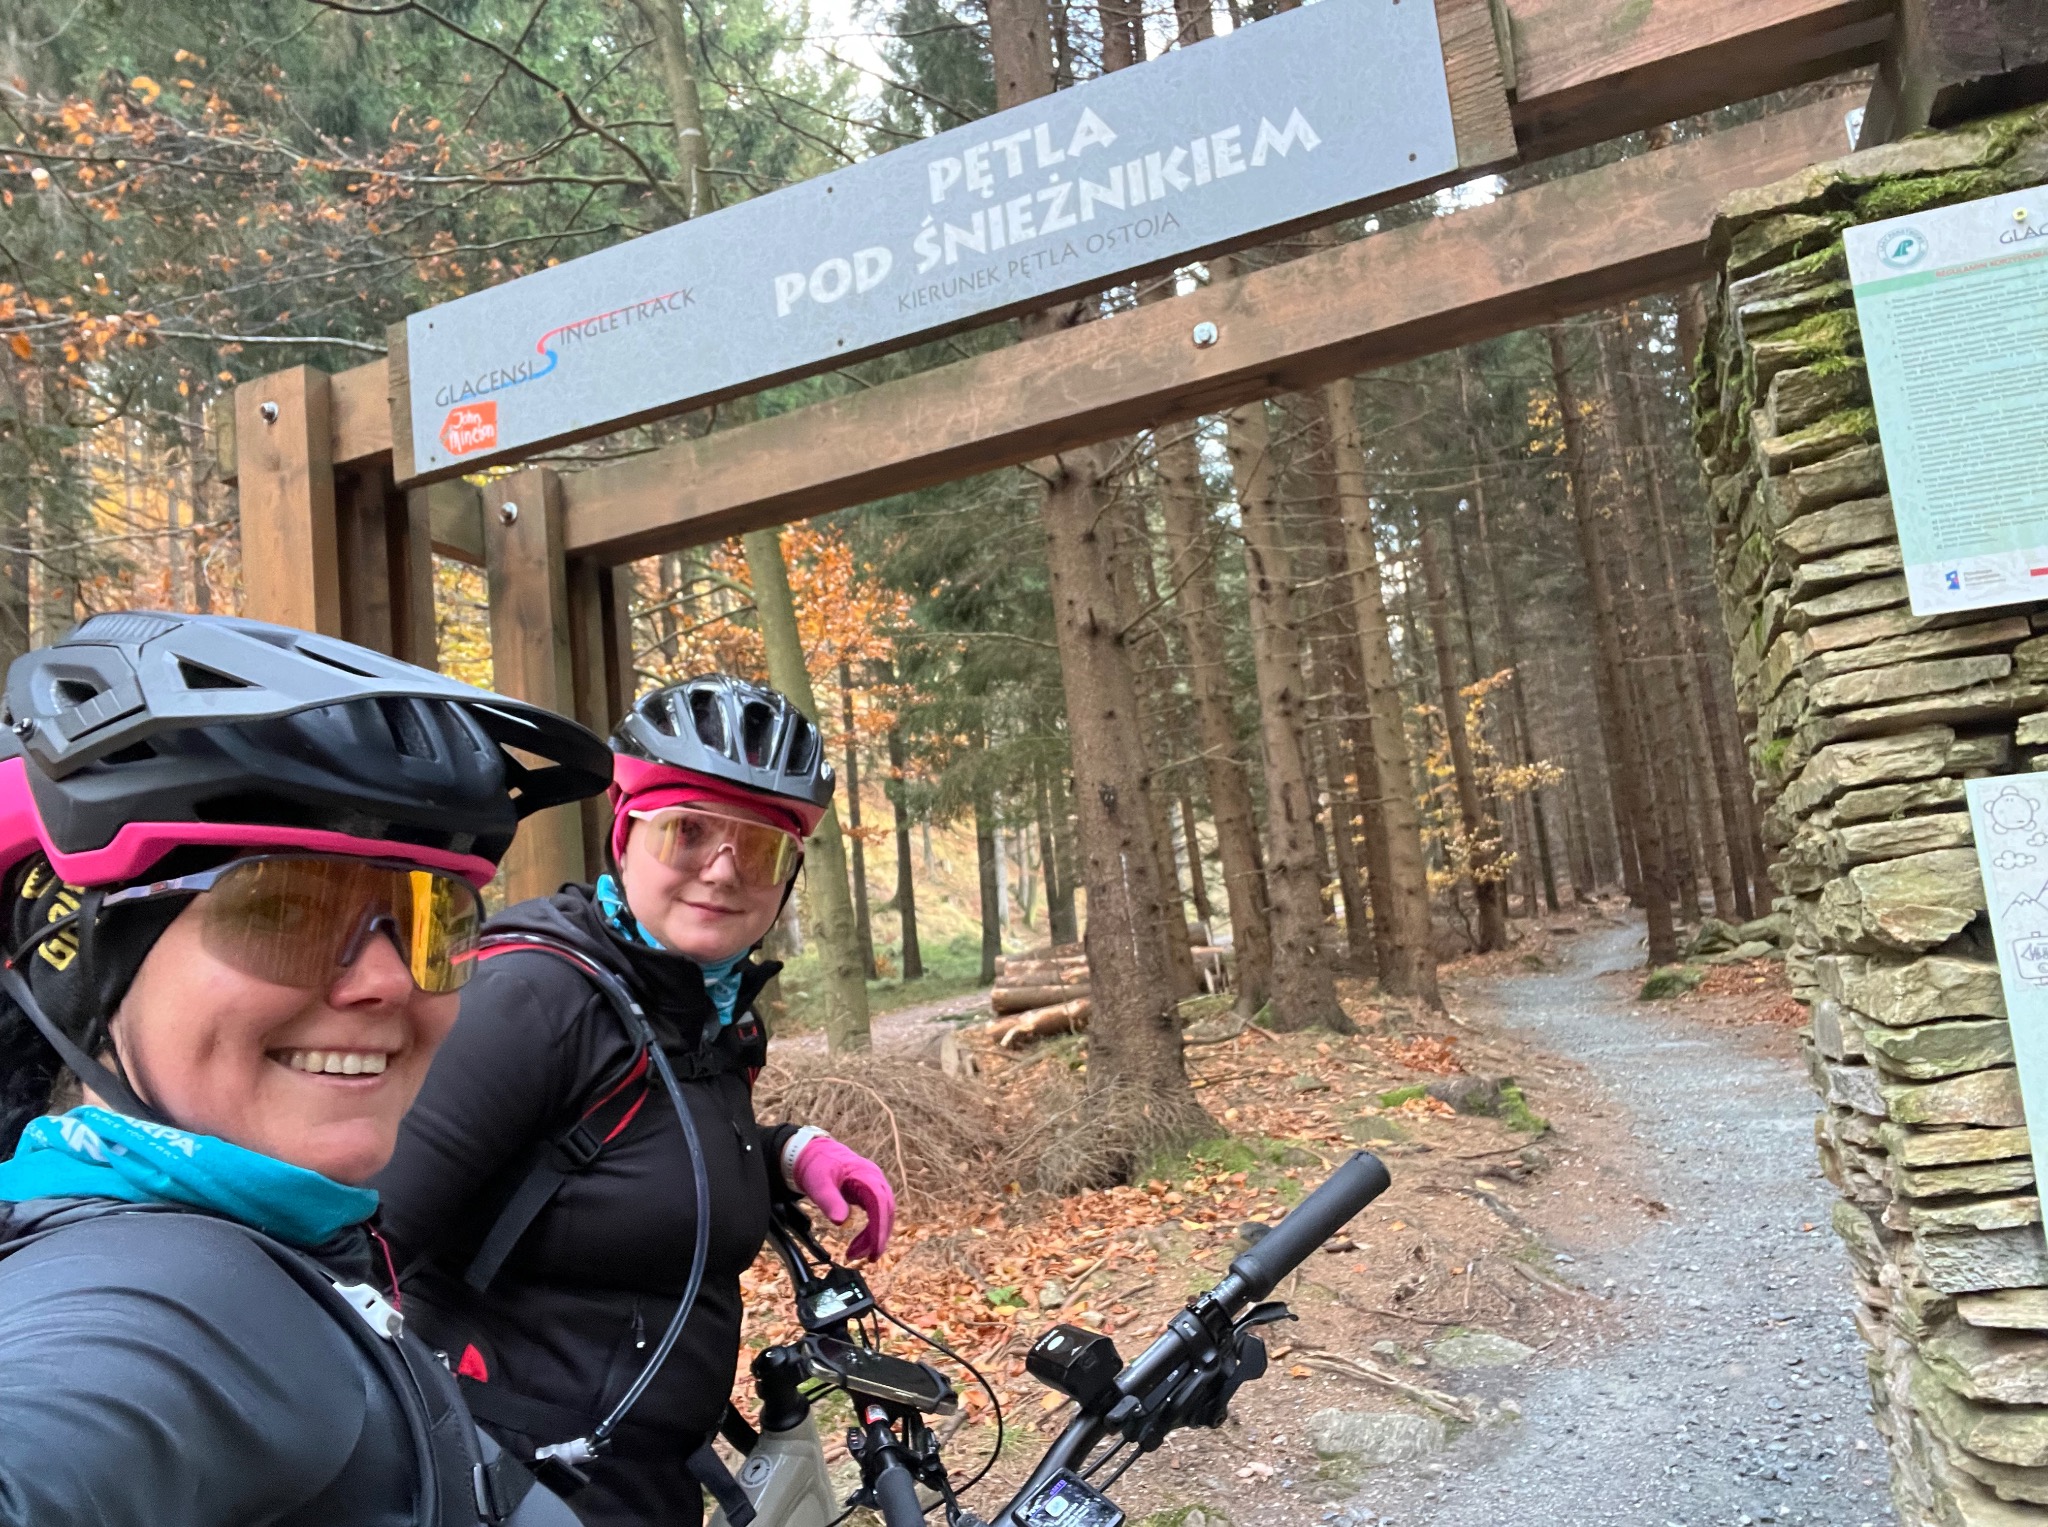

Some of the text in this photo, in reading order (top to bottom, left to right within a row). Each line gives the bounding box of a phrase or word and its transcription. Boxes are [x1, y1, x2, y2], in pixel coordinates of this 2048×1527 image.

[926, 105, 1118, 204] PĘTLA
[773, 106, 1322, 317] POD ŚNIEŻNIKIEM
[898, 211, 1181, 313] KIERUNEK PĘTLA OSTOJA
